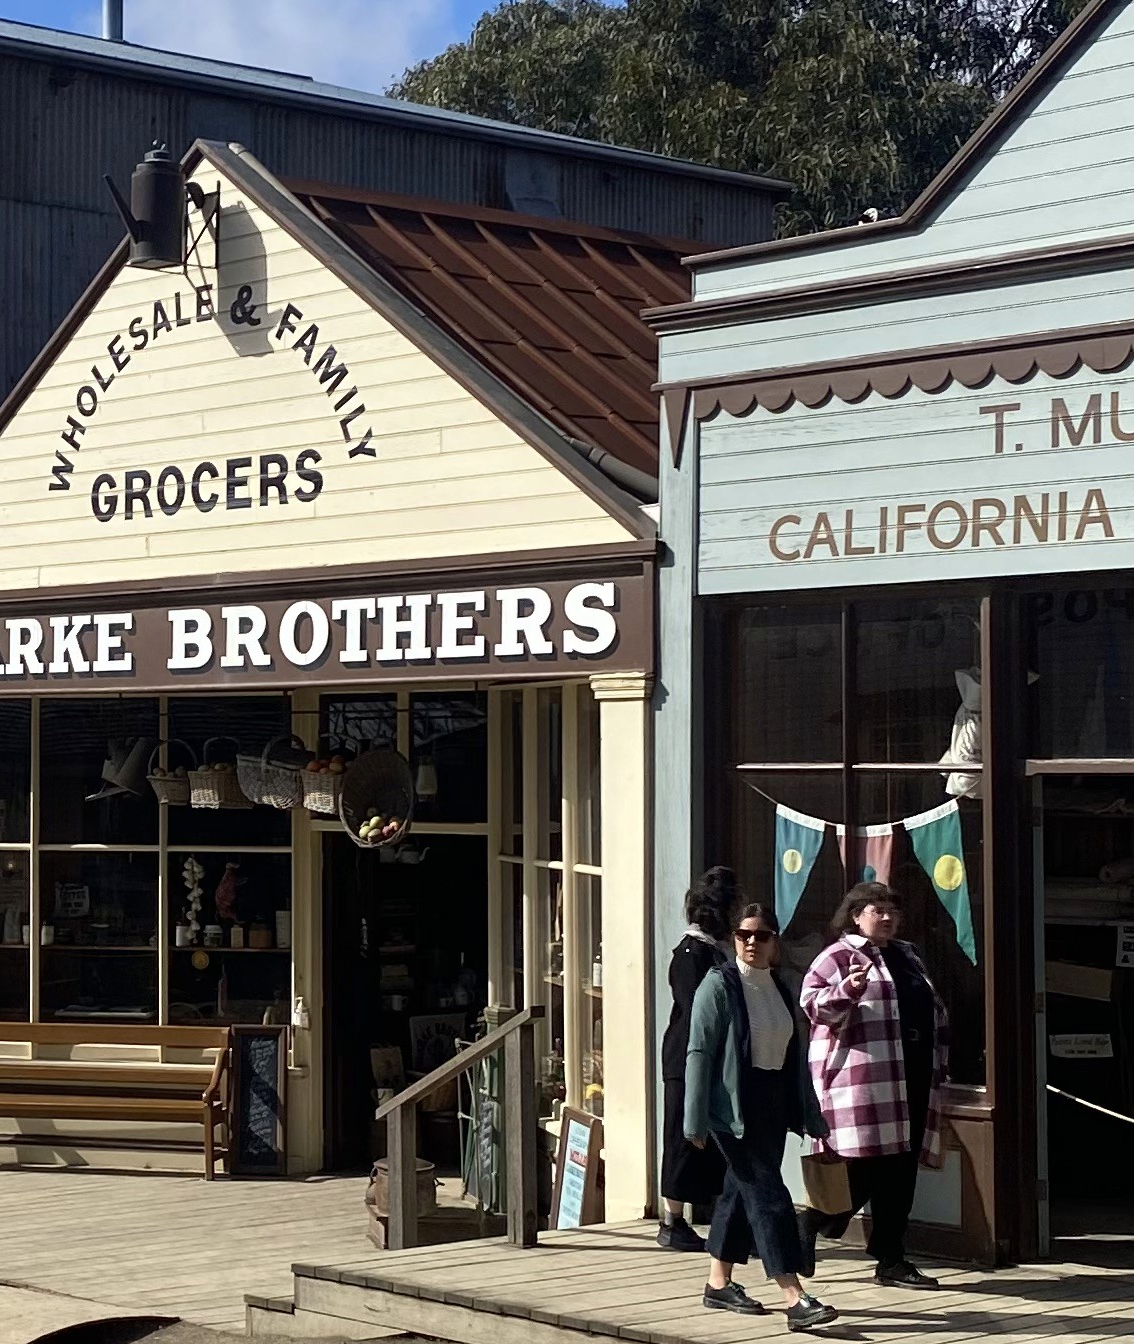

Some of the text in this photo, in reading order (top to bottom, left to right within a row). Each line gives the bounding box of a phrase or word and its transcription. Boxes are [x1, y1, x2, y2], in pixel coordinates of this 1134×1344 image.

[49, 284, 377, 492] WHOLESALE & FAMILY
[979, 402, 1024, 454] T.
[91, 448, 324, 523] GROCERS
[769, 488, 1115, 562] CALIFORNIA
[167, 582, 617, 670] BROTHERS
